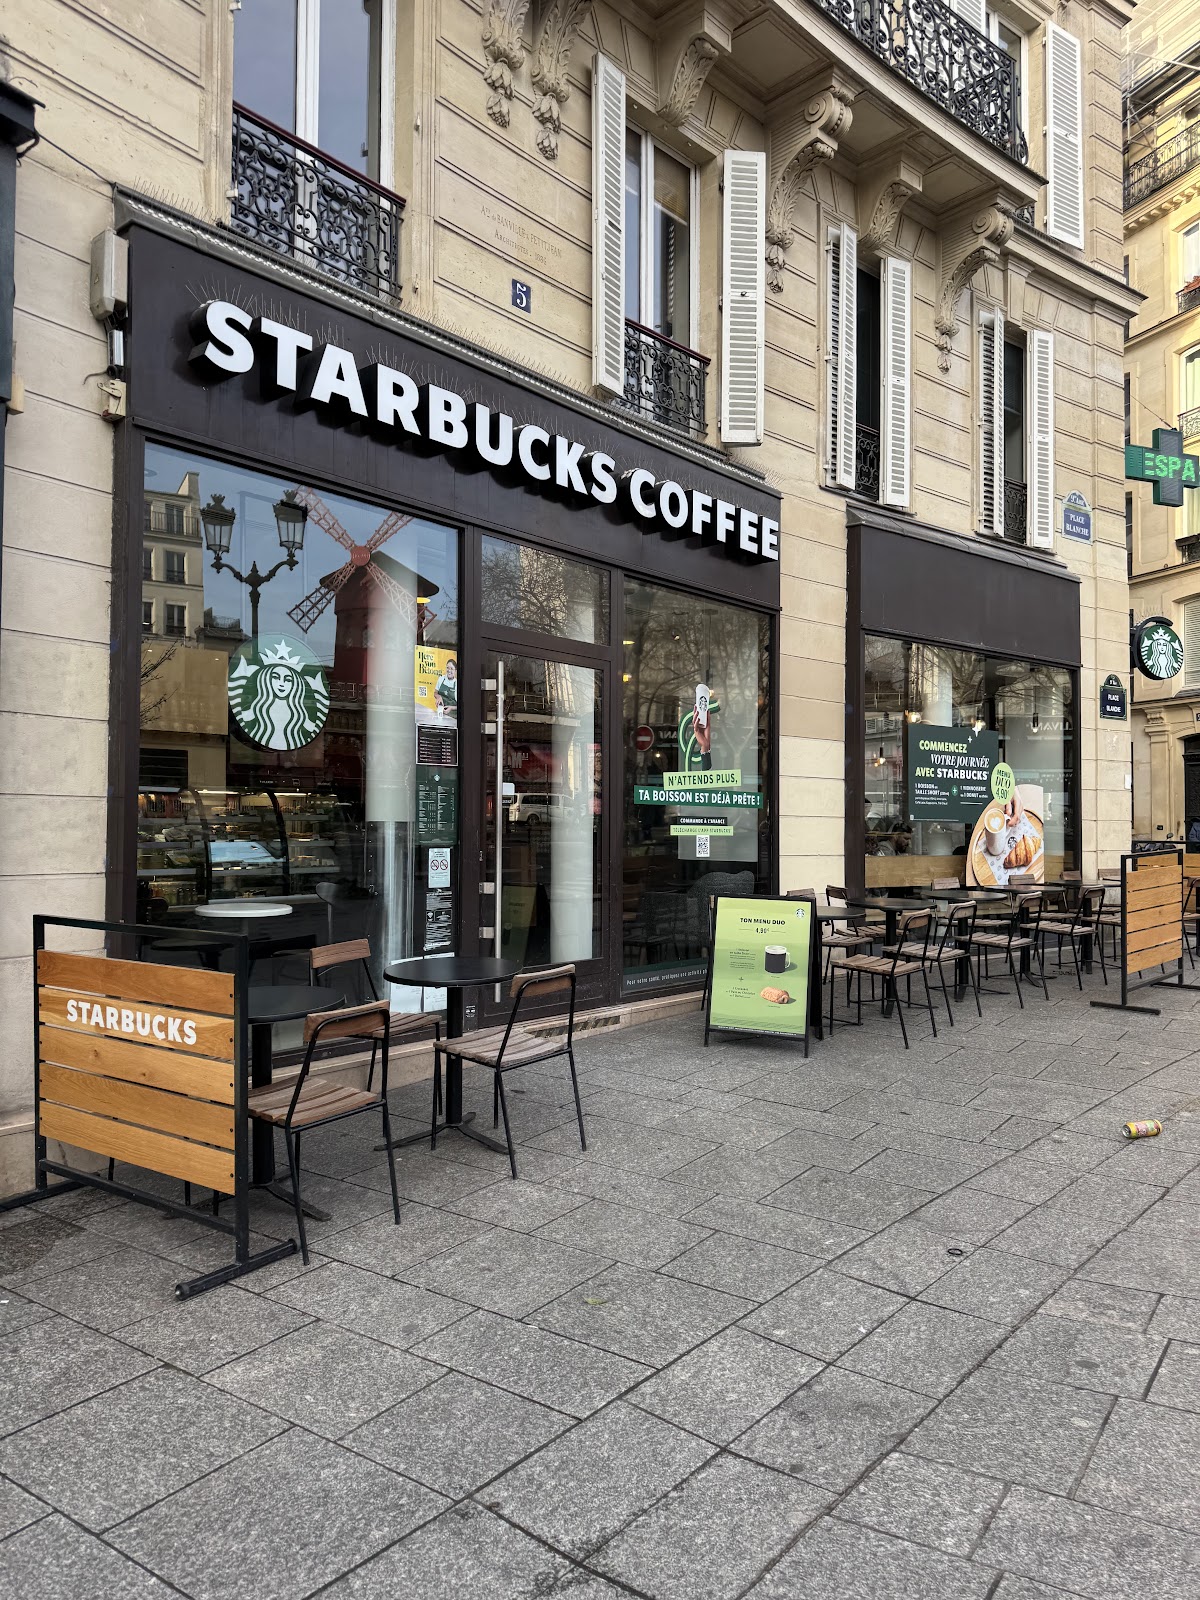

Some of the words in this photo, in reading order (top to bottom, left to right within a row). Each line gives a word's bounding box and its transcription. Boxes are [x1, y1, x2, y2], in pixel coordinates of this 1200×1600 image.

[516, 282, 527, 308] 5
[203, 300, 618, 505] STARBUCKS
[629, 467, 780, 562] COFFEE
[1144, 452, 1196, 482] ESPA
[1070, 513, 1085, 525] PLACE
[1065, 522, 1089, 537] BLANCHE
[919, 740, 968, 754] COMMENCEZ
[930, 754, 955, 766] VOTRE
[955, 755, 990, 768] JOURNÉE
[668, 774, 714, 787] N'ATTENDS
[716, 773, 738, 785] PLUS,
[915, 767, 935, 778] AVEC
[936, 768, 988, 781] STARBUCKS
[995, 776, 1011, 789] DUO
[639, 789, 650, 801] TA
[652, 790, 693, 803] BOISSON
[694, 792, 709, 803] EST
[711, 791, 731, 805] DÉJÀ
[733, 792, 756, 806] PRÊTE
[66, 999, 197, 1045] STARBUCKS
